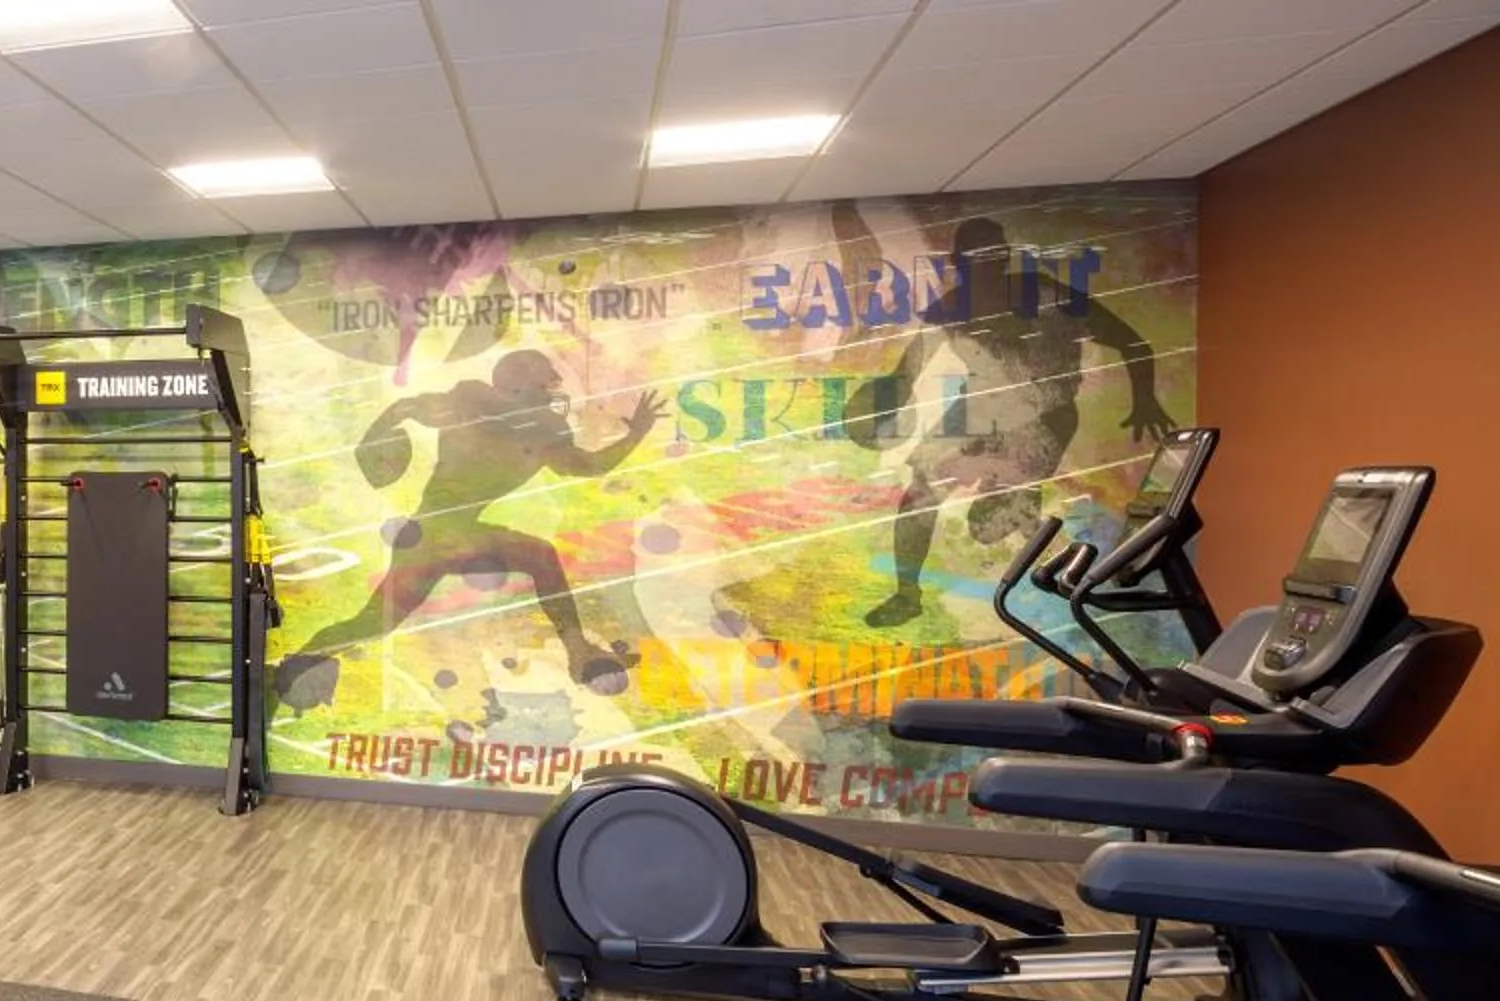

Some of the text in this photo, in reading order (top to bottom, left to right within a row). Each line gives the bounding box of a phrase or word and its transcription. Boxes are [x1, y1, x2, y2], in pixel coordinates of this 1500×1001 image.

[414, 286, 576, 328] SHARPENS
[738, 245, 1101, 331] EARN IT
[78, 374, 209, 398] TRAINING ZONE
[676, 373, 998, 443] SKILL
[325, 732, 991, 817] TRUST DISCIP LOVE COMP
